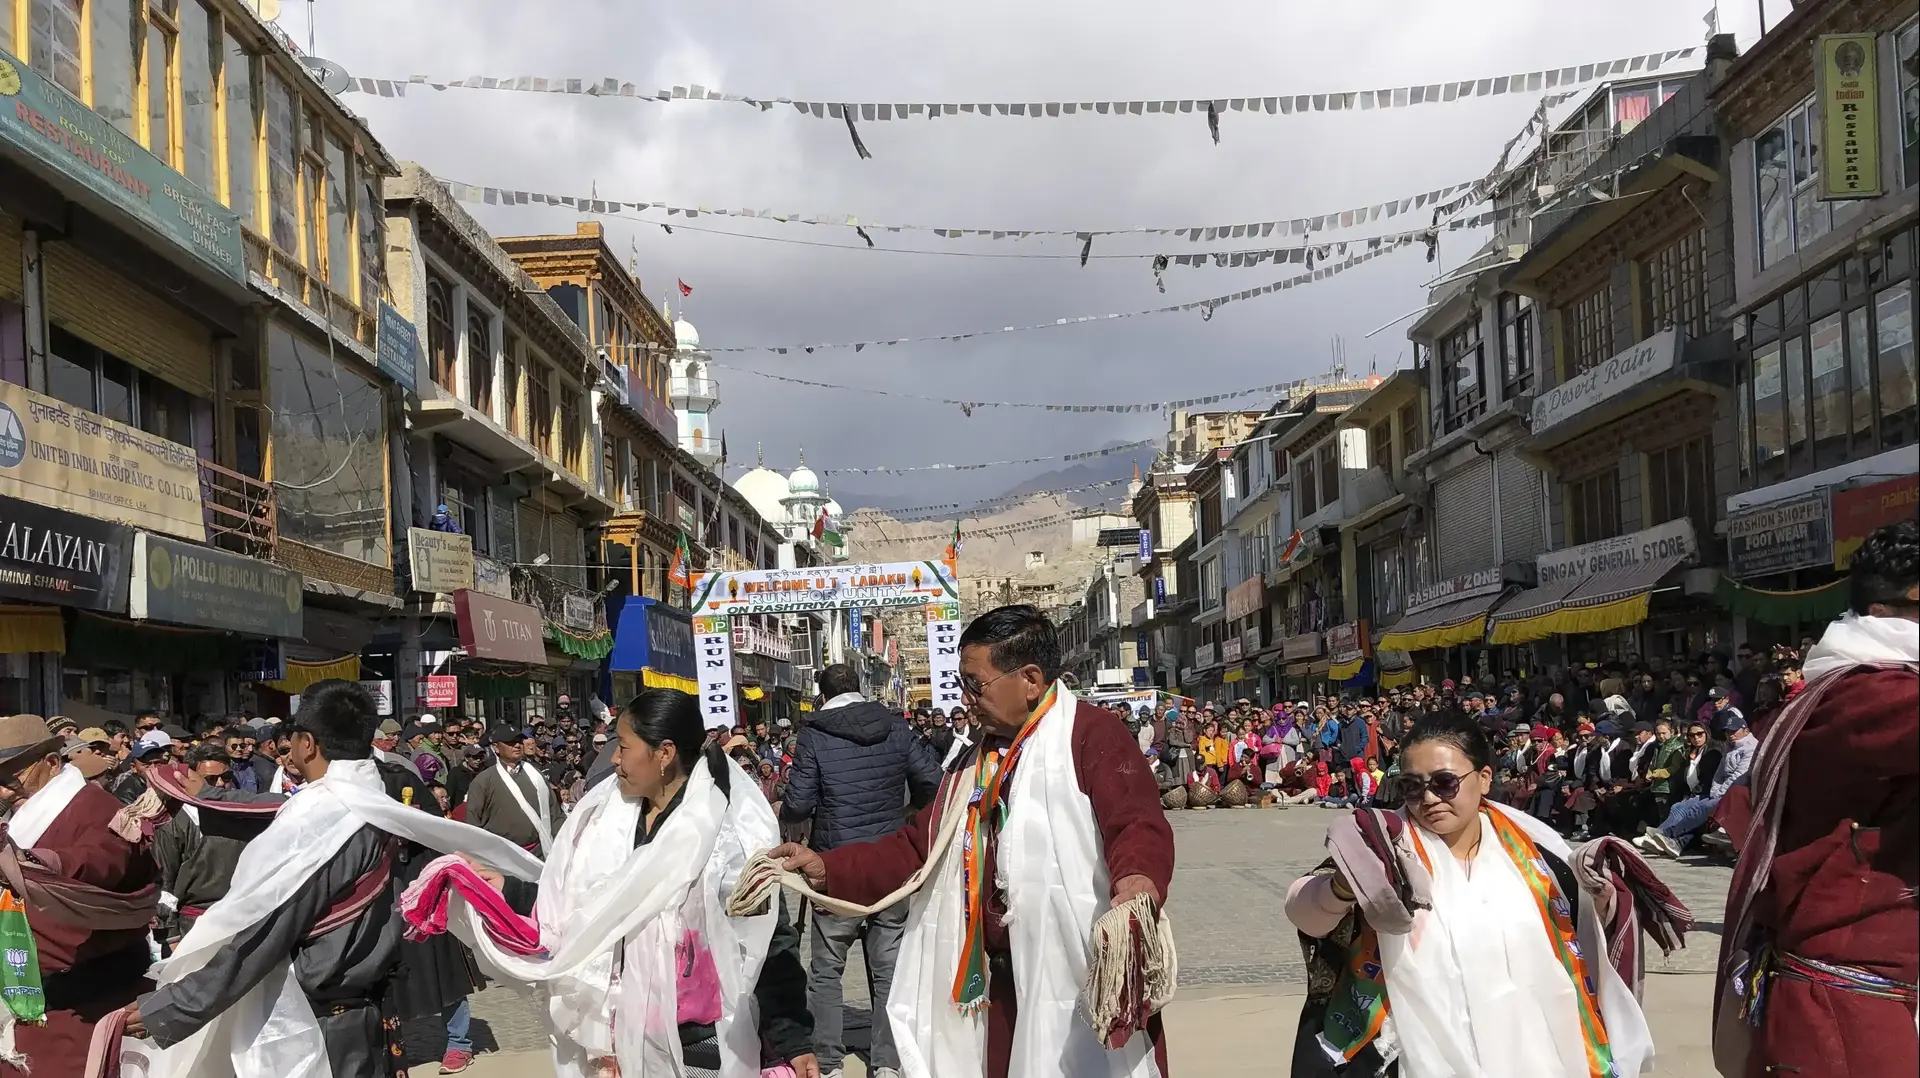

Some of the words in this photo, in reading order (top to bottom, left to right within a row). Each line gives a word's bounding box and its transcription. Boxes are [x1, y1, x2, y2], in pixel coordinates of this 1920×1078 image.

[1835, 89, 1865, 100] Indian
[1840, 80, 1859, 88] South
[15, 99, 152, 199] RESTAURANT
[59, 116, 96, 146] ROOF
[100, 143, 126, 165] TOP
[1841, 103, 1859, 189] Restaurant
[208, 213, 232, 238] FAST
[1549, 371, 1599, 413] Desert
[1604, 346, 1657, 384] Rain
[31, 439, 70, 467] UNITED
[72, 452, 99, 476] INDIA
[100, 461, 155, 491] INSURANCE
[88, 488, 112, 502] BRANCH
[113, 495, 133, 508] OFFICE
[1733, 514, 1775, 534] FASHION
[1778, 501, 1822, 523] SHOPPE
[0, 520, 106, 576] ALAYAN
[414, 532, 446, 552] Beauty's
[1745, 531, 1774, 551] FOOT
[1774, 523, 1808, 544] WEAR
[1541, 558, 1587, 582] SINGAY
[1589, 548, 1639, 573] GENERAL
[1642, 535, 1686, 562] STORE
[0, 568, 31, 586] MINA
[34, 575, 71, 592] SHAWL
[173, 554, 216, 583] APOLLO
[218, 563, 261, 592] MEDICAL
[263, 573, 285, 598] HALL
[743, 579, 811, 593] WELCOME
[851, 573, 907, 587] LADAKH
[1407, 580, 1455, 608] FASHION
[1463, 567, 1500, 589] ZONE
[727, 605, 749, 614] ON
[752, 600, 837, 614] RASHTRIYA
[840, 597, 880, 607] EKTA
[881, 595, 930, 605] DIWAS
[748, 591, 791, 605] RUN
[797, 588, 838, 601] FOR
[842, 585, 905, 599] UNITY
[695, 621, 726, 634] BJP
[927, 609, 958, 620] BJP
[502, 619, 533, 641] TITAN
[935, 624, 956, 655] RUN
[703, 636, 726, 668] RUN
[427, 681, 455, 689] BEAUTY
[708, 682, 730, 714] FOR
[939, 669, 960, 701] FOR
